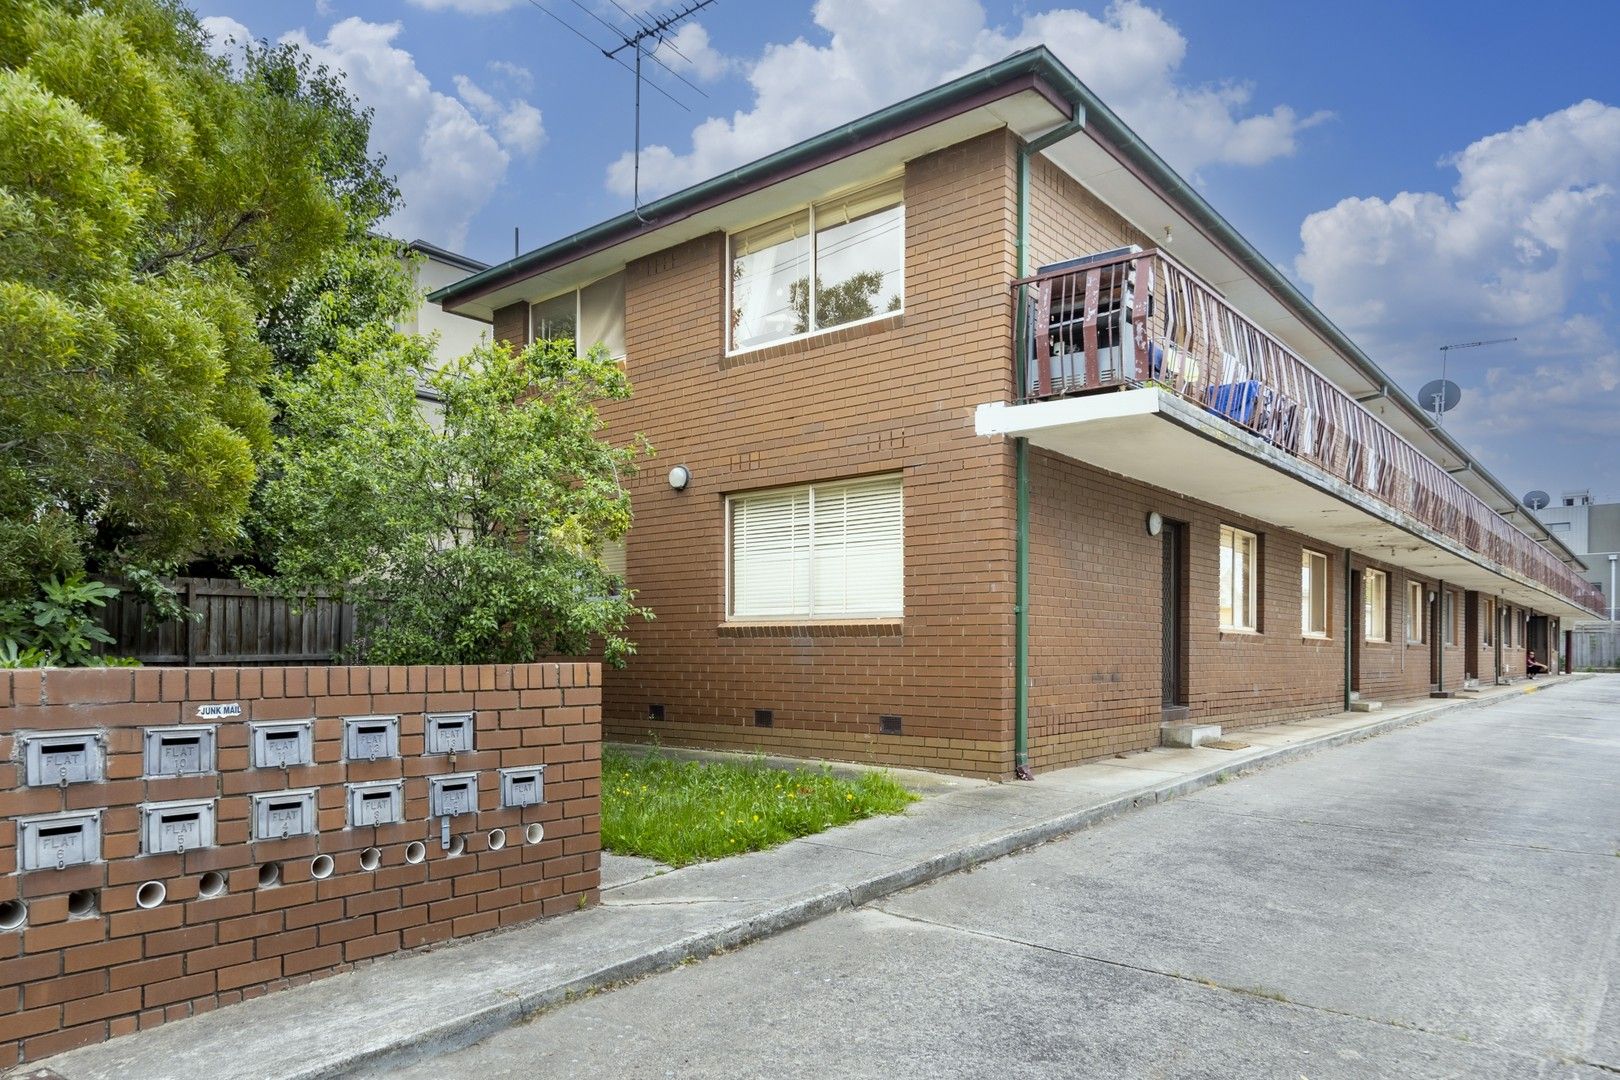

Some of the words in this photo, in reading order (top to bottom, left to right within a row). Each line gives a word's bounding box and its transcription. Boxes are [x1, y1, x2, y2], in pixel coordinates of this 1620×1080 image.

[201, 706, 221, 715] JUNK
[223, 706, 241, 714] MAIL
[440, 729, 460, 738] FLAT
[360, 735, 383, 744] FLAT
[270, 740, 295, 751] FLAT
[165, 747, 195, 757] FLAT
[46, 754, 80, 767] FLAT
[175, 758, 186, 768] 10
[514, 783, 533, 793] FLAT
[443, 791, 464, 801] FLAT
[365, 800, 388, 810] FLAT
[272, 810, 298, 821] FLAT
[165, 822, 195, 834] FLAT
[44, 835, 78, 849] FLAT
[177, 834, 185, 845] 5
